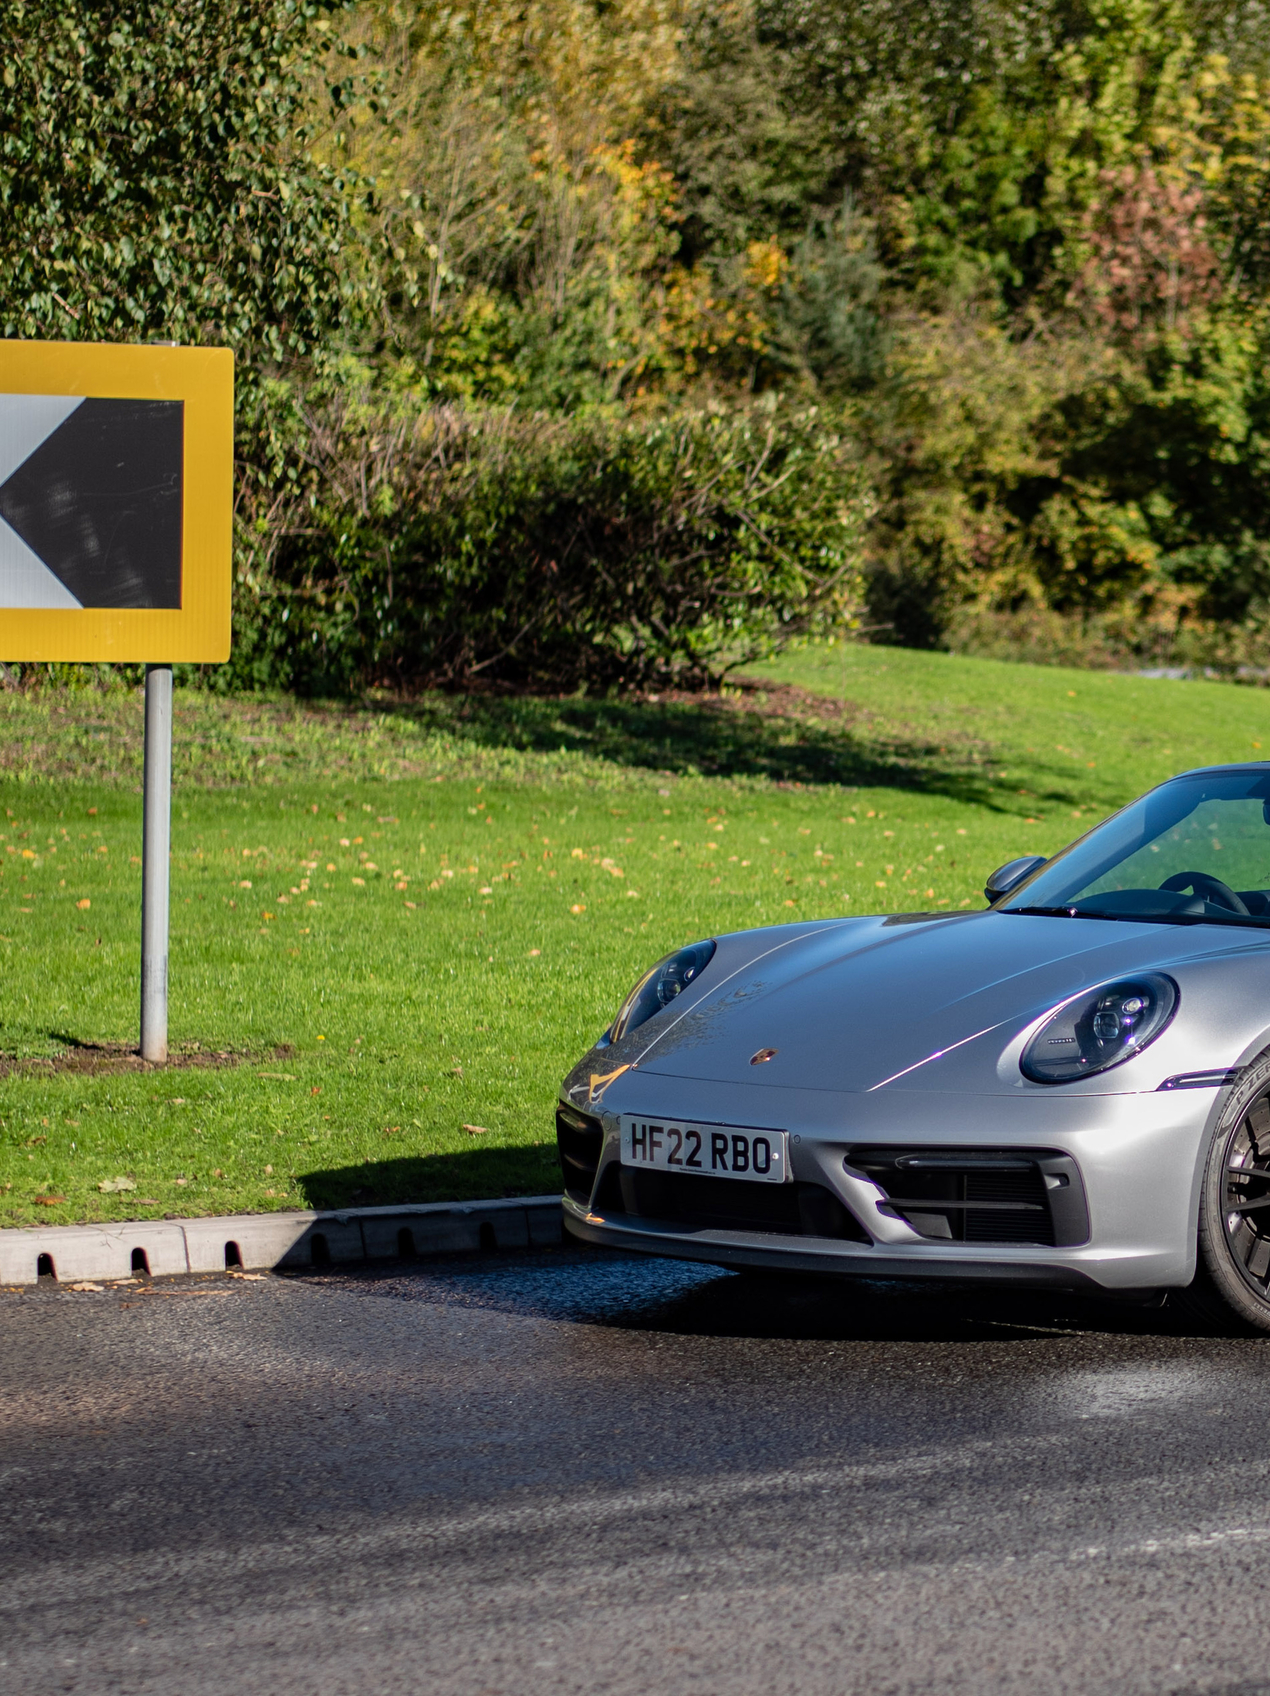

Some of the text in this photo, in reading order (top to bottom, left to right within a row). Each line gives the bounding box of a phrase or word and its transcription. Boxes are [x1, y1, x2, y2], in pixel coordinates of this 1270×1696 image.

[1236, 1090, 1244, 1105] P
[631, 1123, 772, 1174] HF22 RBO
